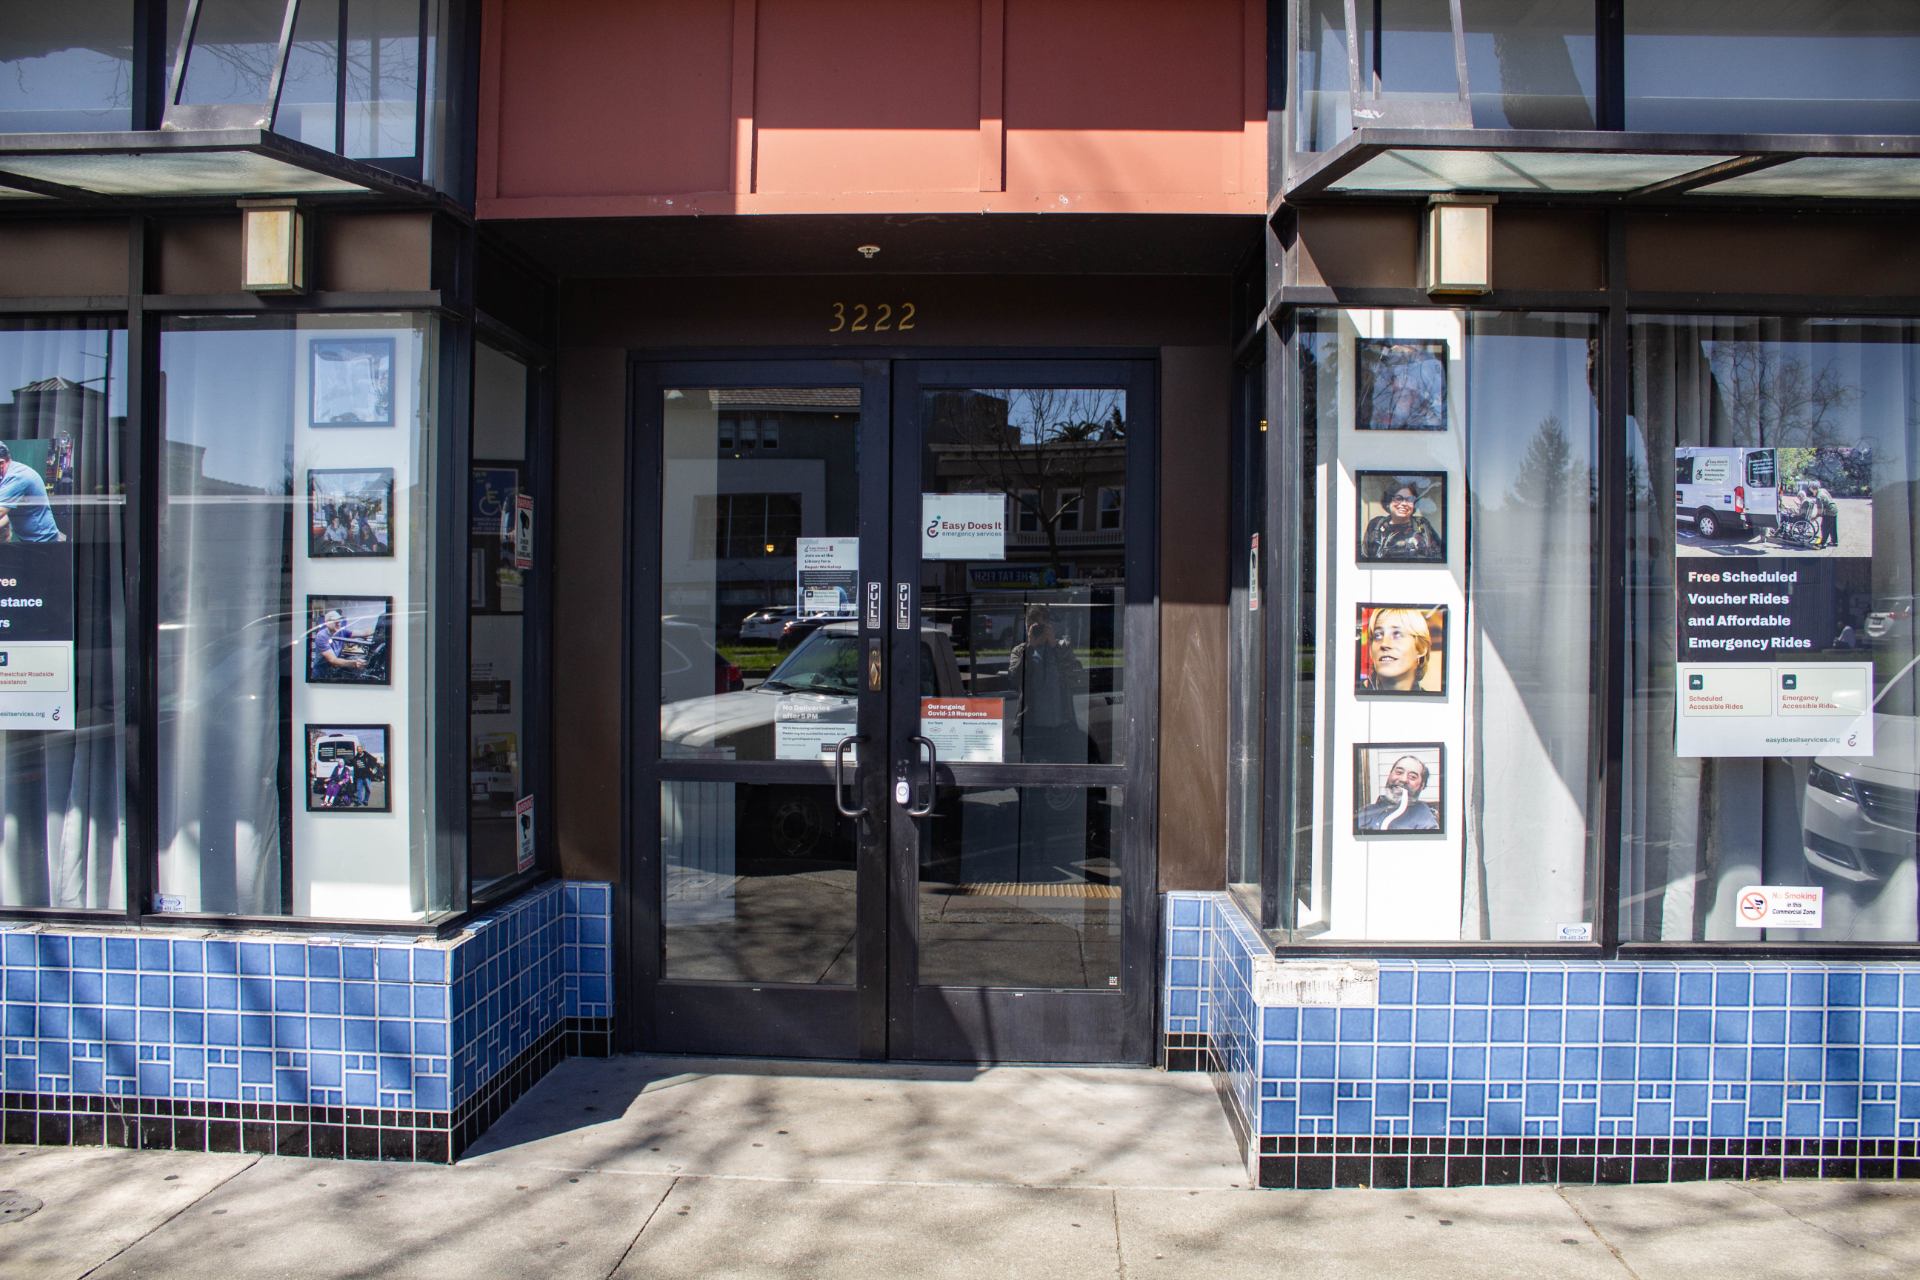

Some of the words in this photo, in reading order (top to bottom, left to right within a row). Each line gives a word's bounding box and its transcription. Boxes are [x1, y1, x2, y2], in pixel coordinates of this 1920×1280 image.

[828, 302, 915, 332] 3222
[942, 521, 966, 531] Easy
[967, 521, 993, 530] Does
[994, 521, 1002, 530] It
[1688, 571, 1720, 583] Free
[1722, 571, 1798, 583] Scheduled
[870, 584, 878, 618] PULL
[900, 584, 908, 618] PULL
[1688, 593, 1748, 605] Voucher
[1749, 593, 1789, 605] Rides
[1688, 615, 1715, 626] and
[1717, 615, 1791, 627] Affordable
[1688, 637, 1769, 651] Emergency
[1771, 637, 1811, 648] Rides
[1782, 694, 1819, 702] Emergency
[1765, 736, 1840, 744] easydoesitservices.org
[1784, 892, 1817, 902] Smoking
